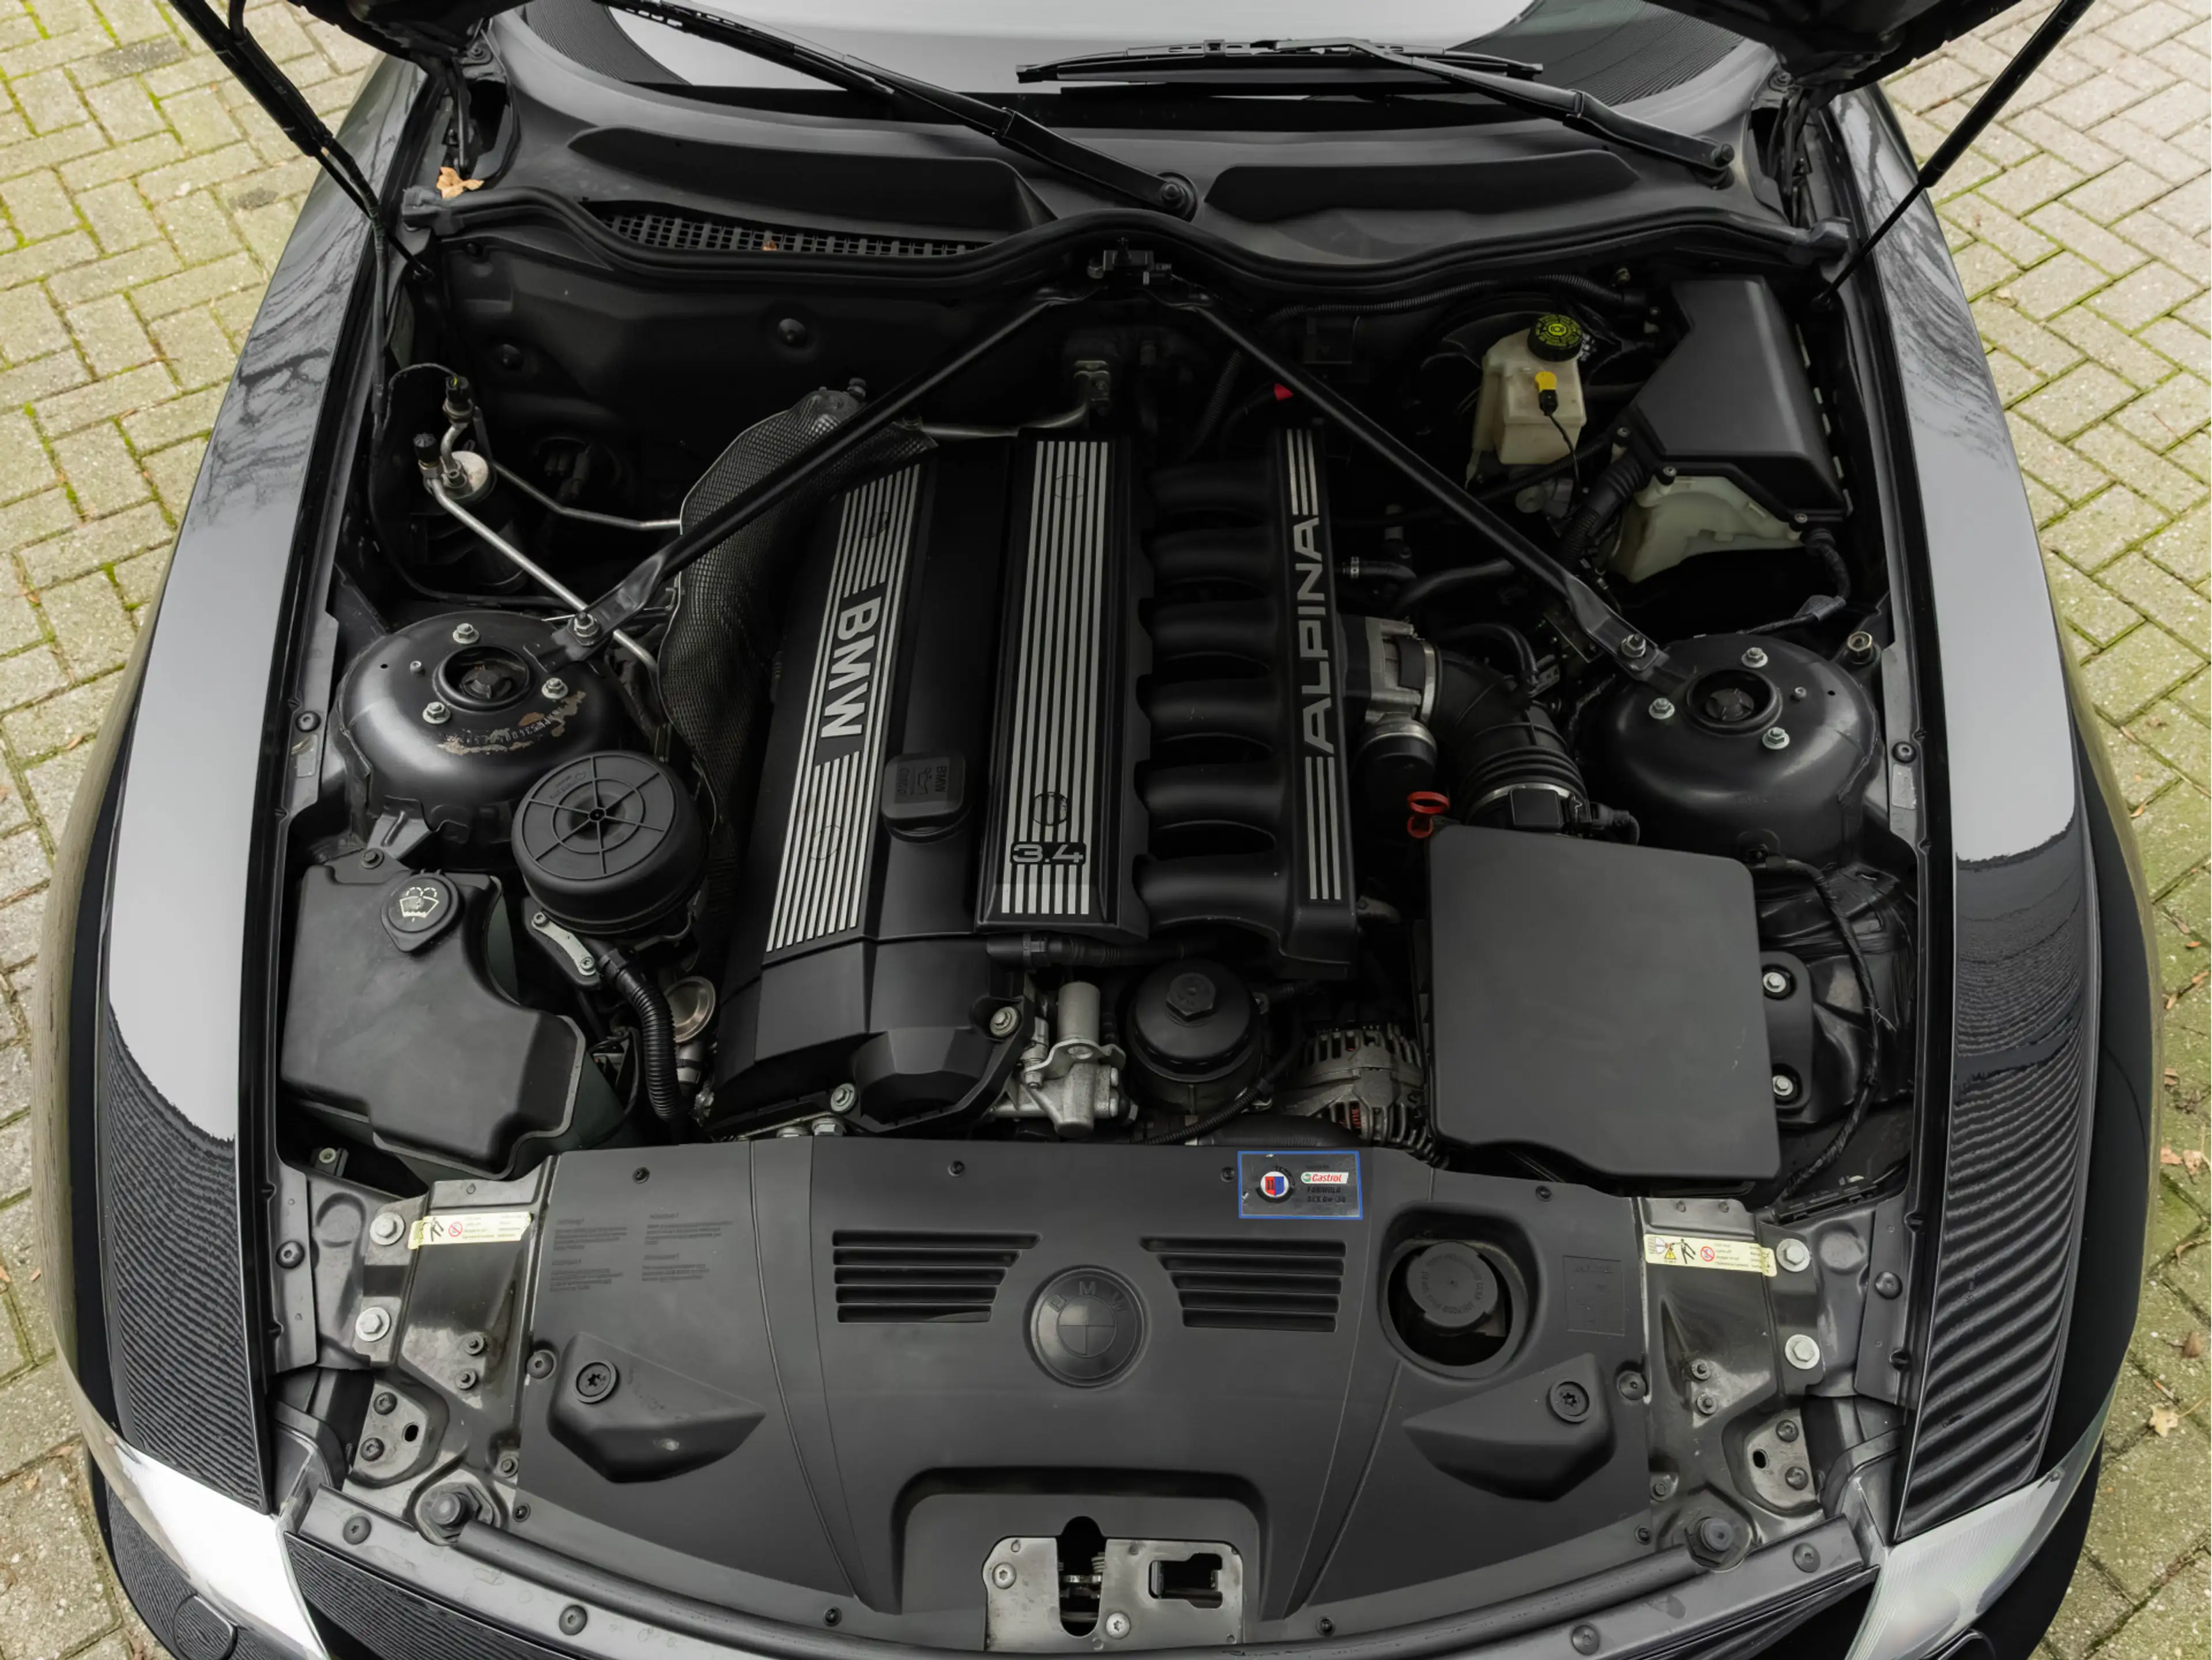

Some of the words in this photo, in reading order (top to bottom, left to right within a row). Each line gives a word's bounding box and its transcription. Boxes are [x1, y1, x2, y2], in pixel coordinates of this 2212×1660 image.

[1293, 518, 1335, 754] ALPINA
[820, 597, 881, 738] BMW
[1012, 844, 1084, 863] 3.4
[1312, 1174, 1342, 1182] Castrol
[1048, 1281, 1127, 1312] BMW
